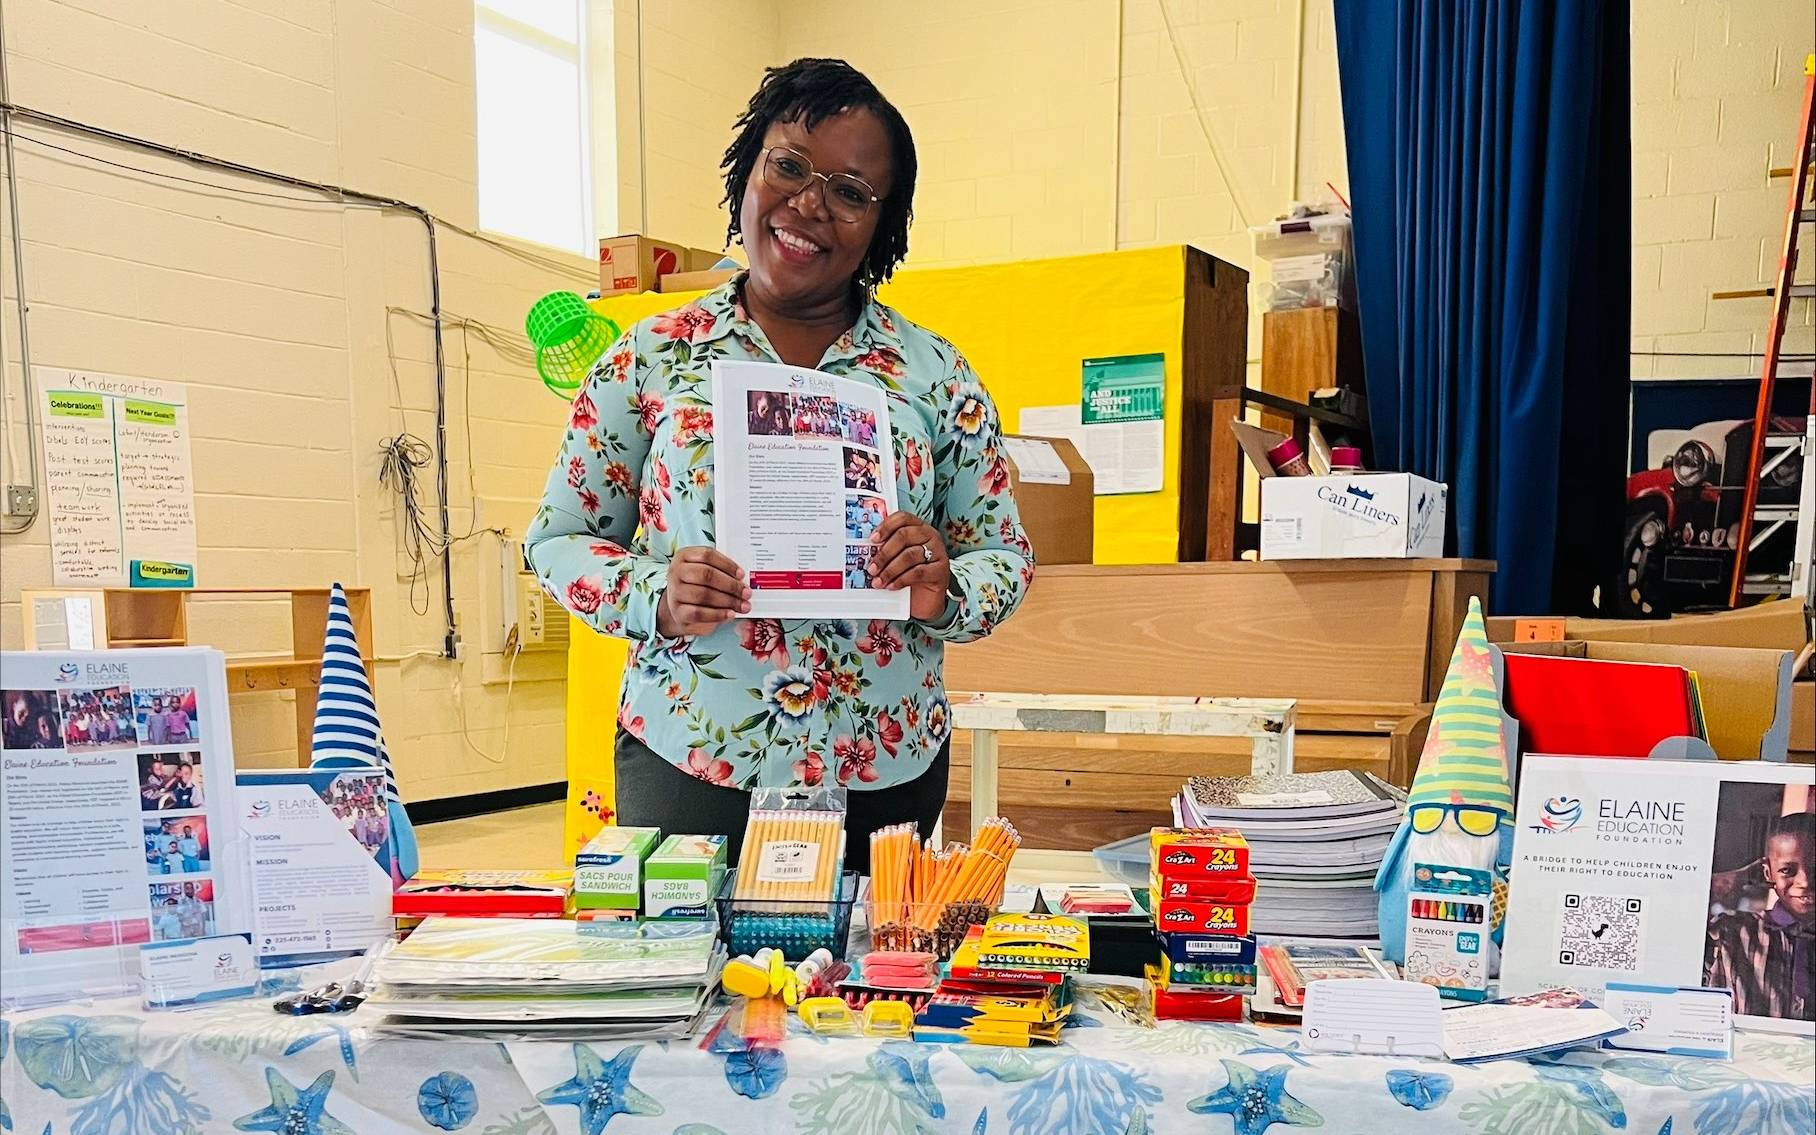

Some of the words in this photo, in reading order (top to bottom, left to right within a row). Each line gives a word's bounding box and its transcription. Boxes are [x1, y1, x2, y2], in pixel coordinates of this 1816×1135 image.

[69, 371, 163, 397] Kindergarten
[1317, 485, 1347, 507] Can
[1352, 496, 1400, 526] Liners
[142, 563, 188, 576] Kindergarten
[86, 662, 129, 674] ELAINE
[278, 797, 319, 810] ELAINE
[1599, 798, 1686, 822] ELAINE
[1597, 820, 1685, 836] EDUCATION
[254, 833, 281, 841] VISION
[1596, 834, 1683, 846] FOUNDATION
[256, 857, 288, 865] MISSION
[1211, 849, 1235, 865] 24
[1205, 862, 1239, 872] Crayons
[1533, 855, 1567, 864] BRIDGE
[1571, 857, 1582, 865] TO
[1586, 858, 1610, 867] HELP
[1613, 860, 1662, 870] CHILDREN
[1666, 863, 1698, 872] ENJOY
[579, 871, 605, 881] SACS
[607, 872, 634, 882] POUR
[1539, 865, 1566, 873] THEIR
[1569, 866, 1598, 875] RIGHT
[1602, 868, 1613, 877] TO
[1617, 870, 1674, 880] EDUCATION
[581, 881, 632, 891] SANDWICH
[663, 882, 689, 891] BAGS
[1170, 883, 1189, 894] 24
[651, 891, 702, 901] SANDWICH
[258, 904, 296, 912] PROJECTS
[1210, 906, 1235, 923] 24
[1204, 920, 1238, 930] Crayons
[1412, 926, 1454, 937] CRAYONS
[997, 971, 1022, 979] Colored
[1022, 972, 1044, 980] Pencils
